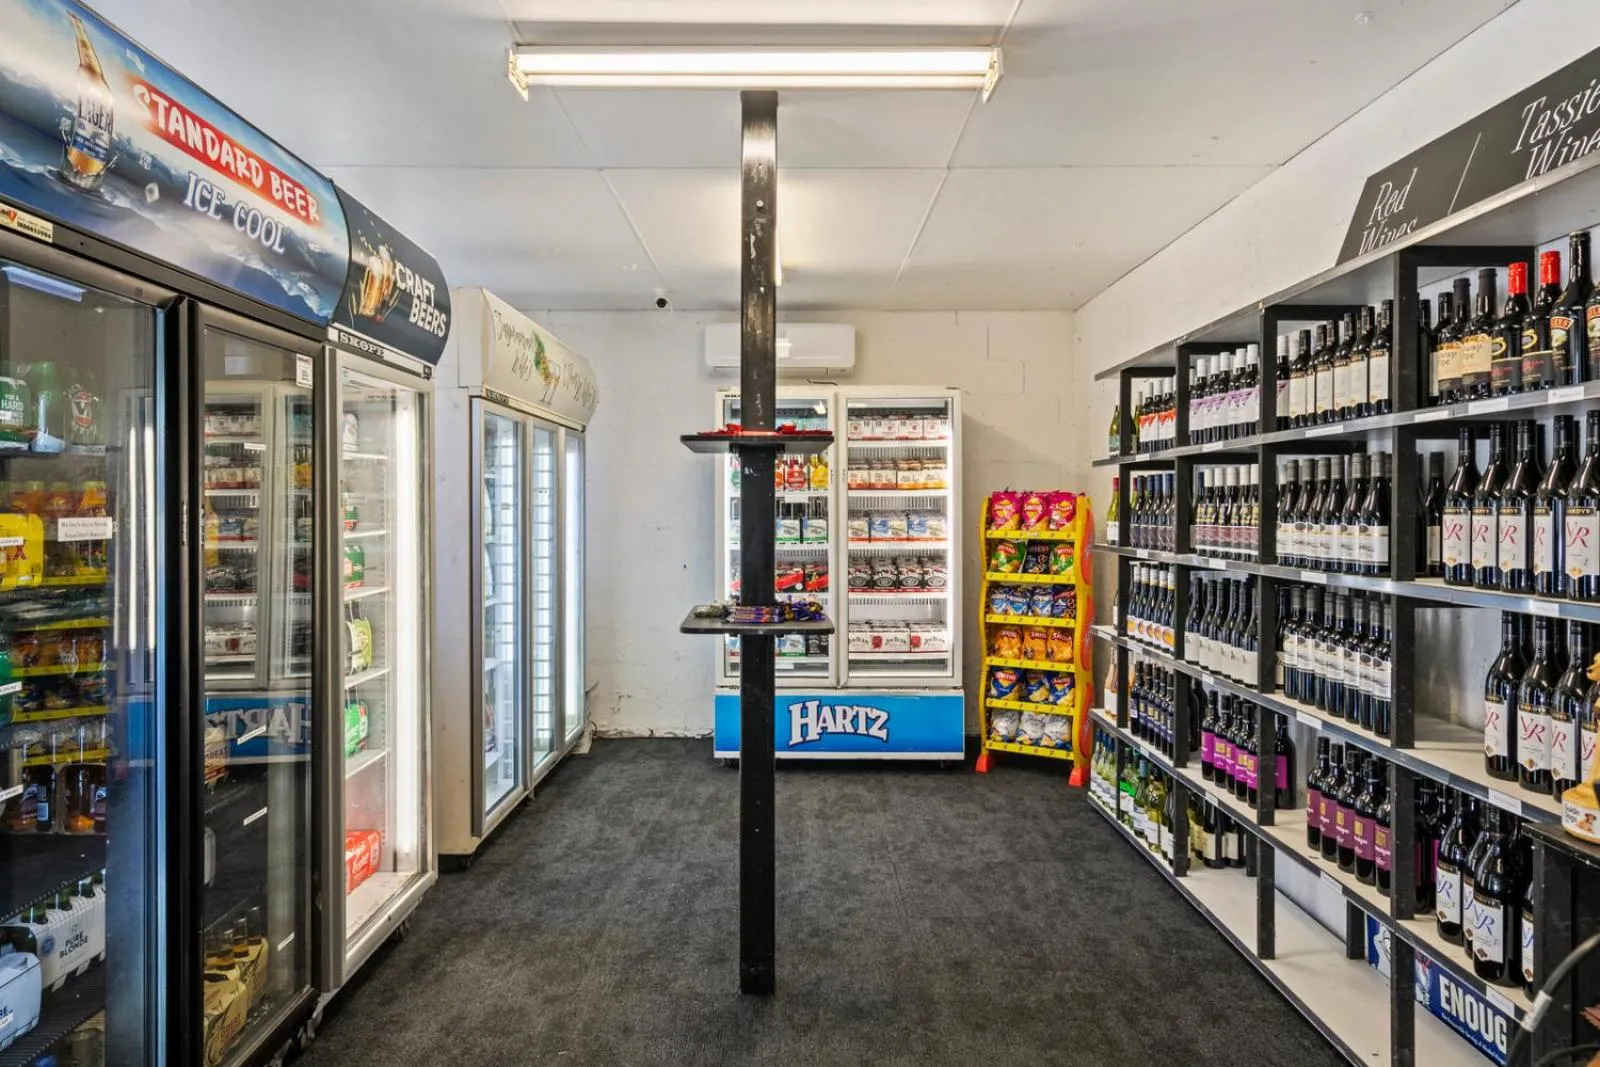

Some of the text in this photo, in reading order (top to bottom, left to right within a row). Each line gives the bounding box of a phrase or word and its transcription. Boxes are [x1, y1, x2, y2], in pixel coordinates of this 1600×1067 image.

[1512, 78, 1600, 154] Tassie
[133, 84, 321, 223] STANDARD BEER
[184, 171, 286, 254] ICE COOL
[1368, 167, 1419, 227] Red
[1358, 217, 1419, 256] Wines
[394, 260, 435, 306] CRAFT
[409, 299, 446, 337] BEERS
[340, 331, 385, 359] SKOPE
[1, 399, 24, 411] HARD
[789, 700, 889, 745] HARTZ
[60, 936, 88, 957] BLONDE
[65, 931, 84, 947] PURE
[1440, 974, 1507, 1054] ENOUG
